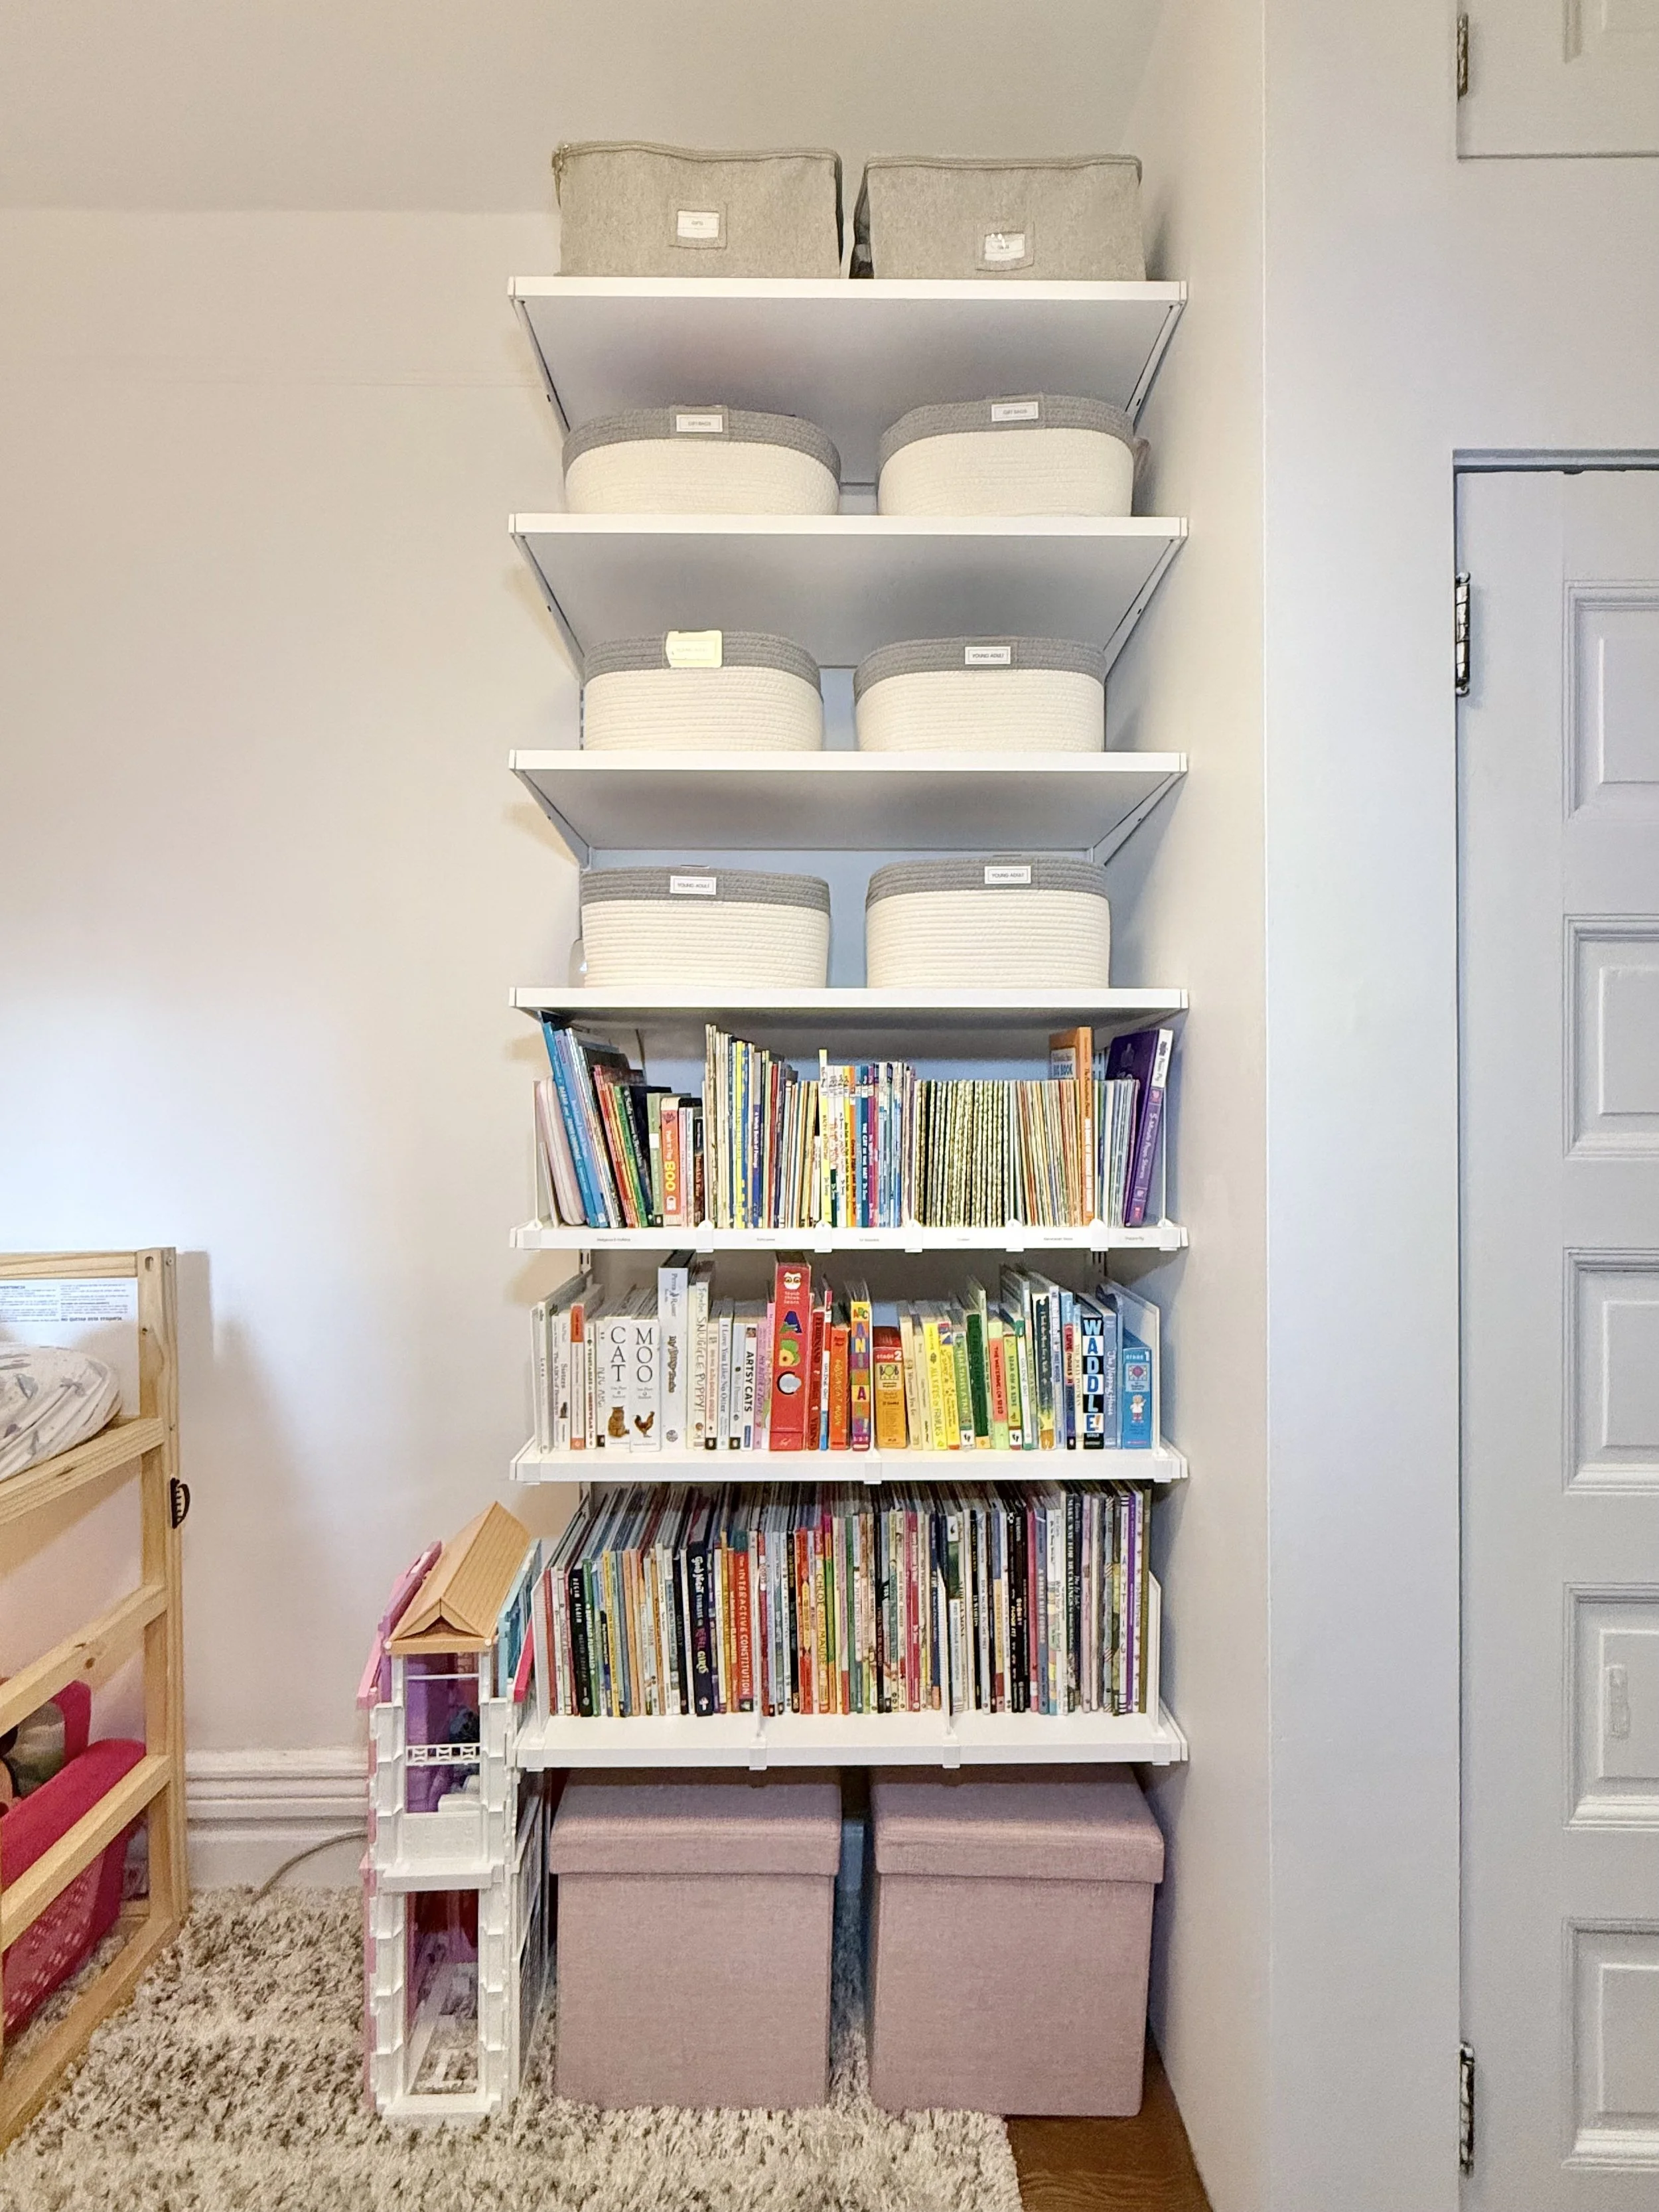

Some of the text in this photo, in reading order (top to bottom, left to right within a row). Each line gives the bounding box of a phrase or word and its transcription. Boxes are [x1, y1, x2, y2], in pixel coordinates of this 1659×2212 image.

[664, 1161, 676, 1191] BOO
[853, 1307, 868, 1319] ABC
[611, 1326, 626, 1382] CAT
[636, 1327, 653, 1382] MOO
[695, 1317, 706, 1412] SNUGGLE PUPPY!
[894, 1350, 902, 1361] 2
[1144, 1351, 1149, 1361] 1
[721, 1381, 728, 1392] No
[834, 1359, 843, 1402] GOODNIGHT
[1009, 1373, 1015, 1383] ON
[1084, 1319, 1102, 1432] WADDLE!
[1107, 1351, 1116, 1415] The Napping House
[696, 1651, 708, 1674] GIRLS
[741, 1634, 750, 1694] CONSTITUTION
